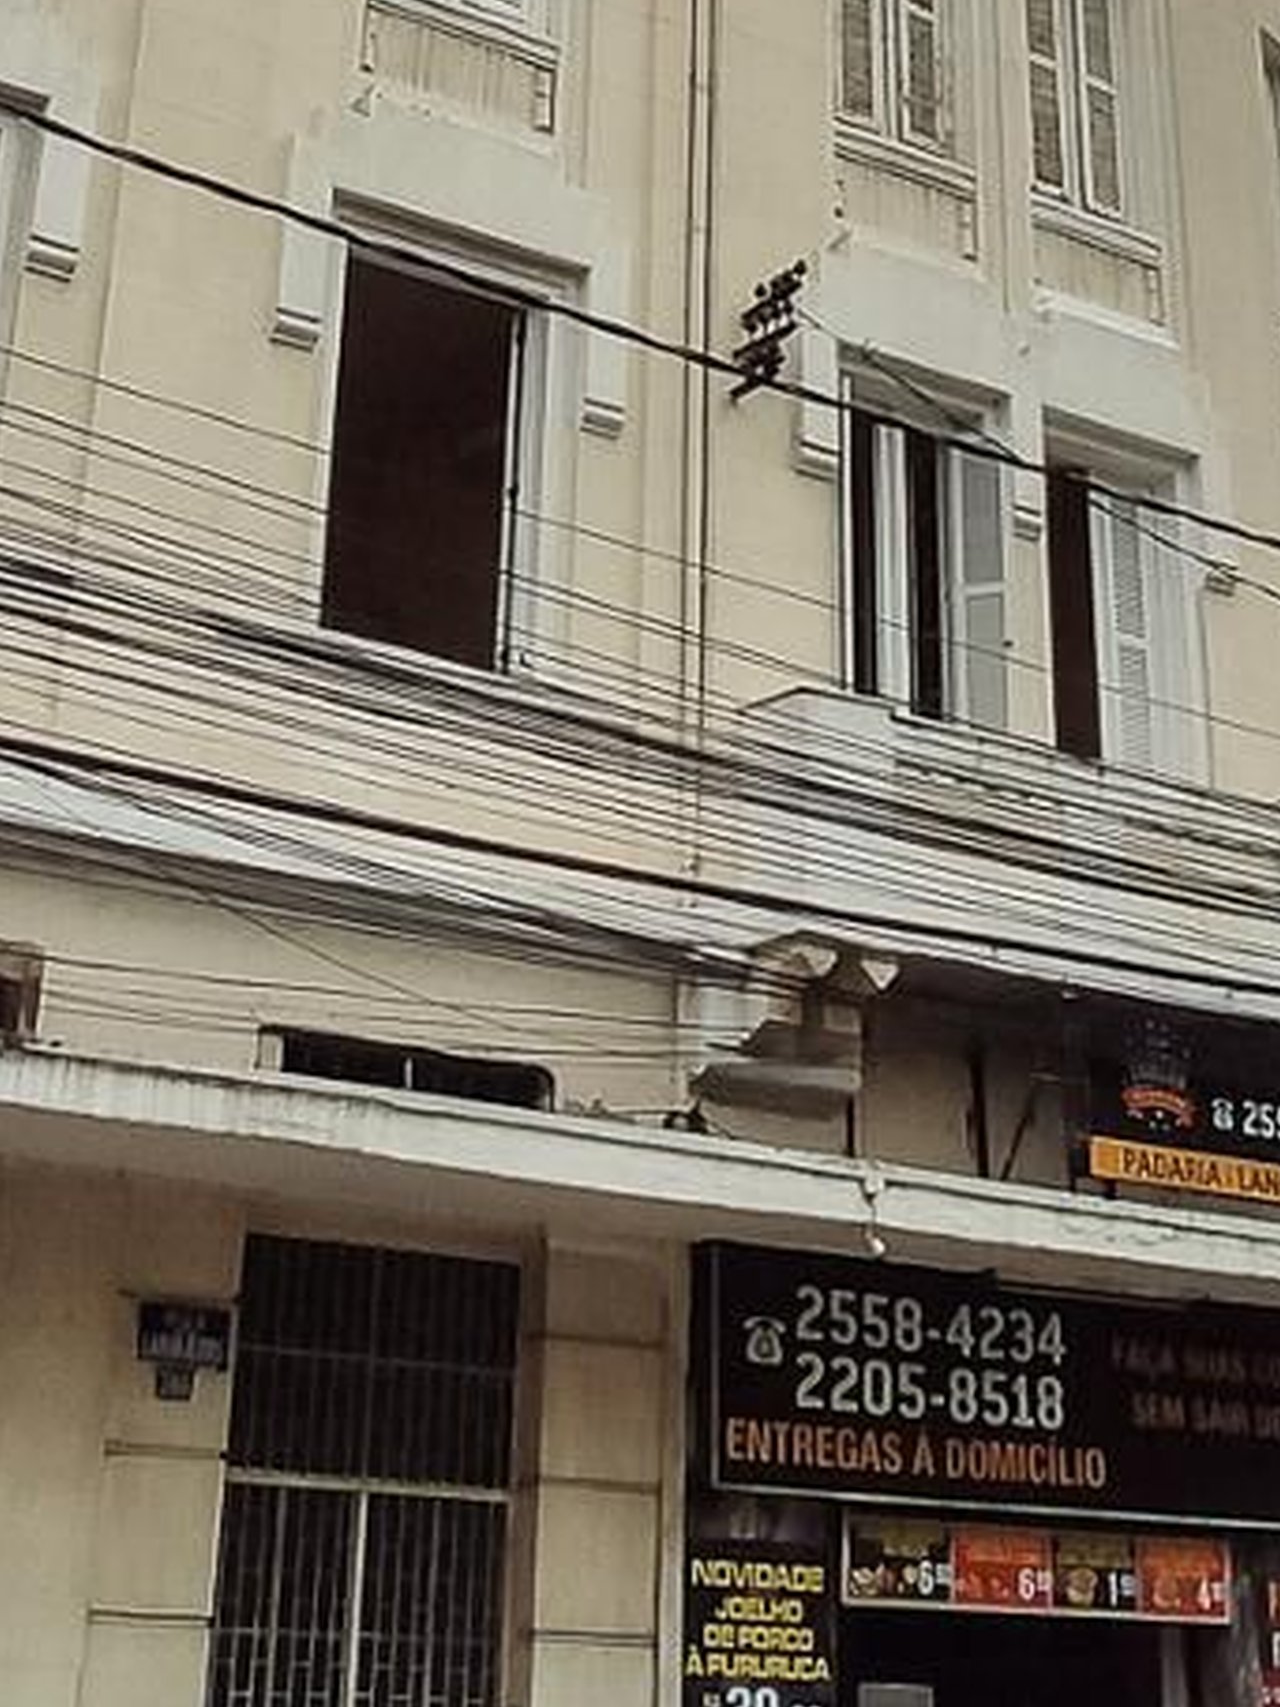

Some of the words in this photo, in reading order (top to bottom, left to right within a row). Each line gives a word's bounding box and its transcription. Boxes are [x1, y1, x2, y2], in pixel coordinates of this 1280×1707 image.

[1122, 1147, 1222, 1186] PADARIA
[795, 1285, 1067, 1366] 2558-4234
[795, 1352, 1066, 1430] 2205-8518
[726, 1417, 903, 1477] ENTREGAS
[946, 1434, 1108, 1488] DOMICÍLIO
[691, 1558, 824, 1593] NOVIDADE
[714, 1596, 803, 1624] JOELHO
[703, 1623, 735, 1648] DE
[738, 1624, 814, 1652] PORCO
[706, 1653, 831, 1681] PURURUCA
